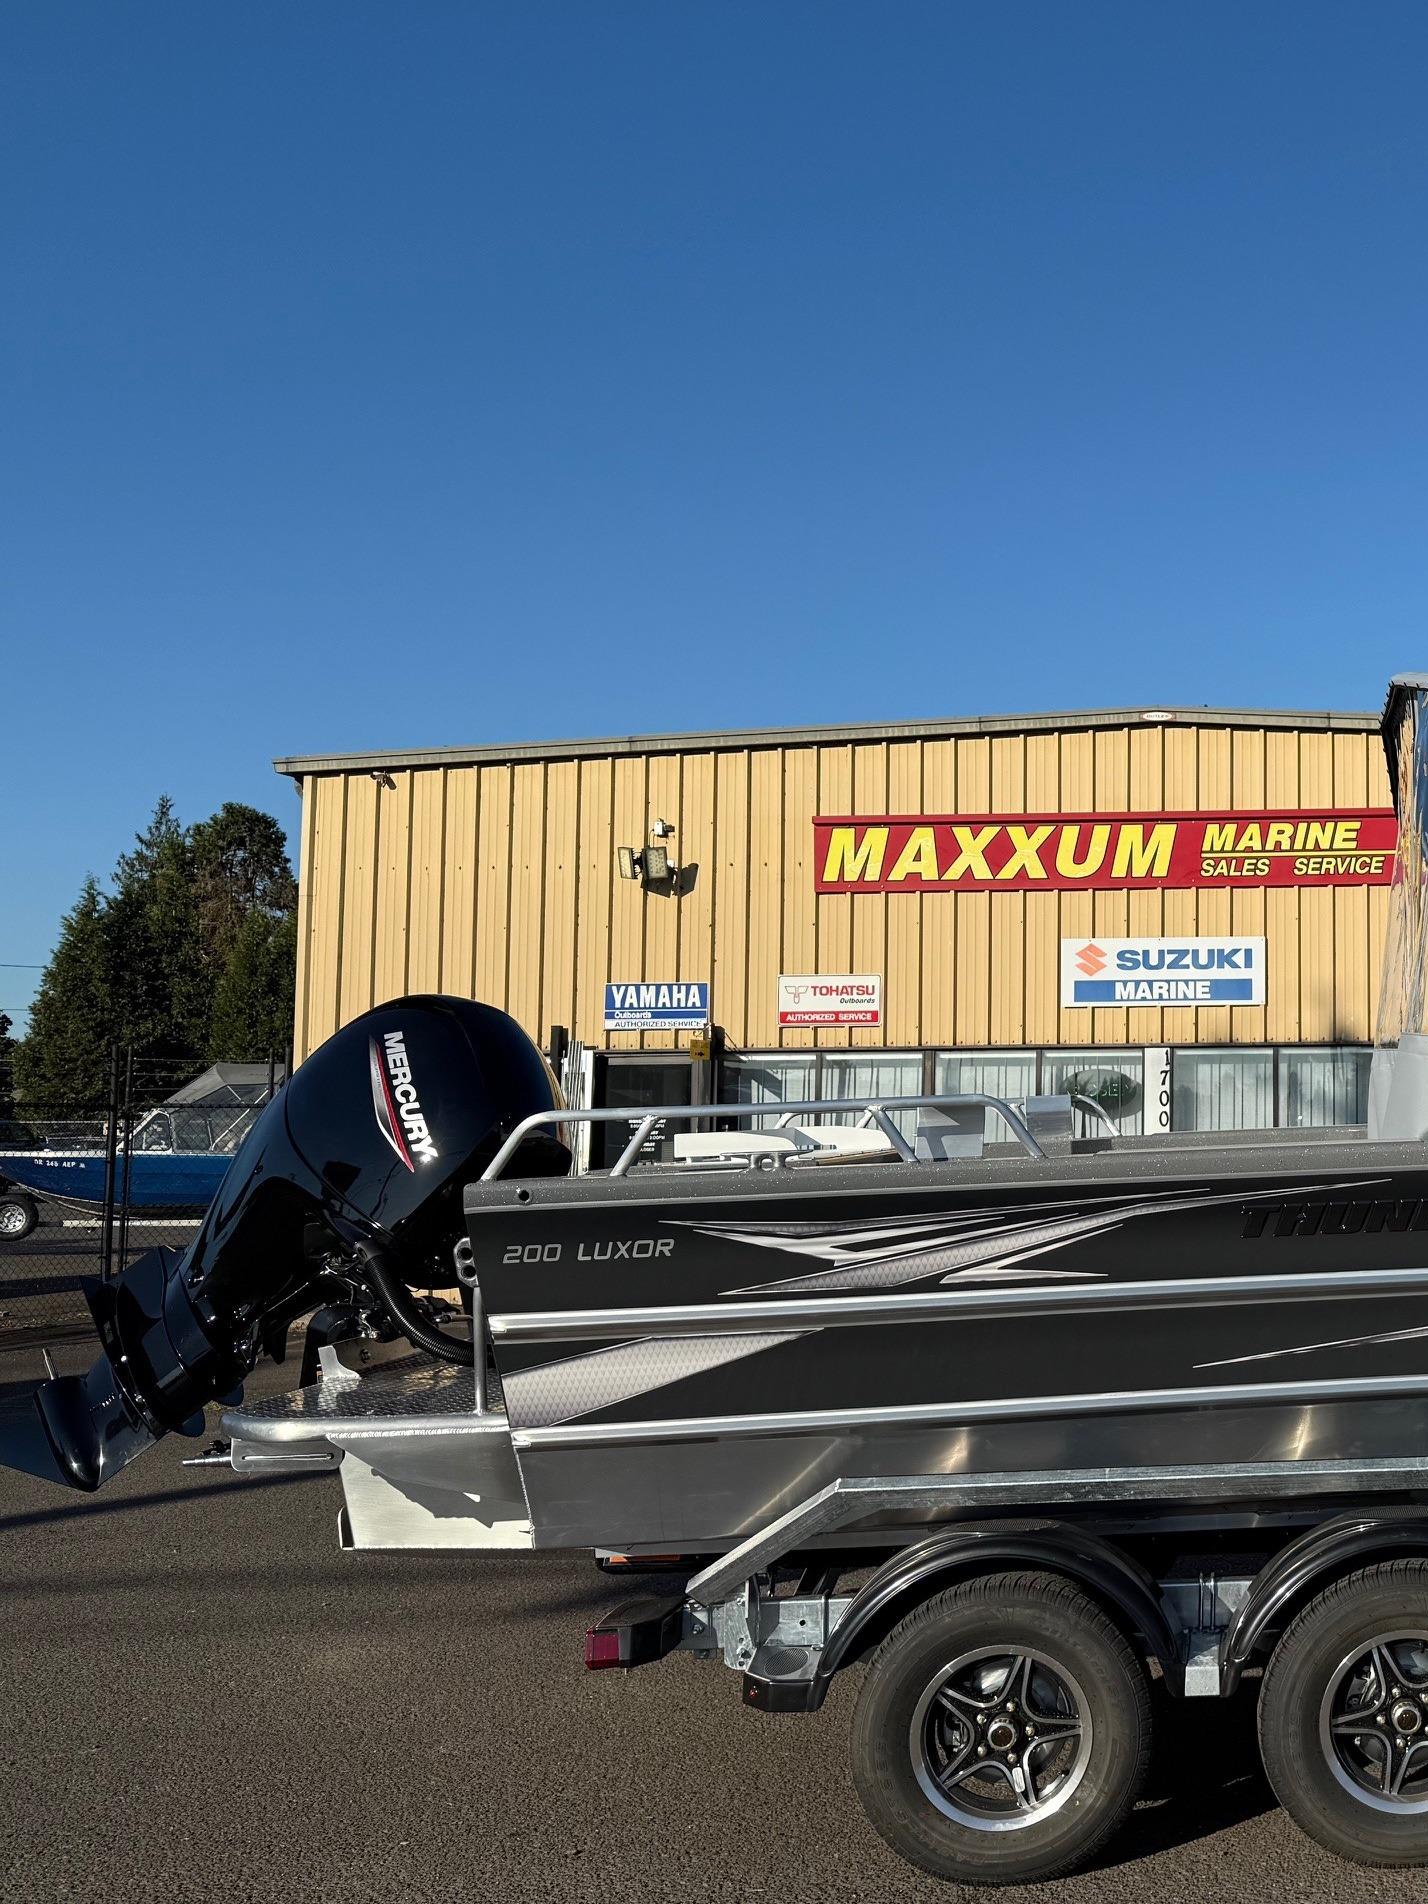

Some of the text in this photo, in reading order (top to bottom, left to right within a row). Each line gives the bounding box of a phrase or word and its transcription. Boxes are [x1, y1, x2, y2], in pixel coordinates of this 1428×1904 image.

[1201, 820, 1362, 851] MARINE
[821, 823, 1178, 883] MAXXUM
[1200, 856, 1386, 878] SALES SERVICE
[1116, 948, 1253, 971] SUZUKI
[611, 985, 701, 1008] YAMAHA
[811, 985, 875, 996] TOHATSU
[1115, 980, 1211, 1000] MARINE
[614, 1011, 652, 1019] Outboards
[615, 1020, 667, 1028] AUTHORIZED
[786, 1013, 836, 1021] AUTHORIZED
[384, 1031, 439, 1158] MERCURY
[1158, 1049, 1171, 1127] 1700
[503, 1239, 675, 1264] 200 LUXOR
